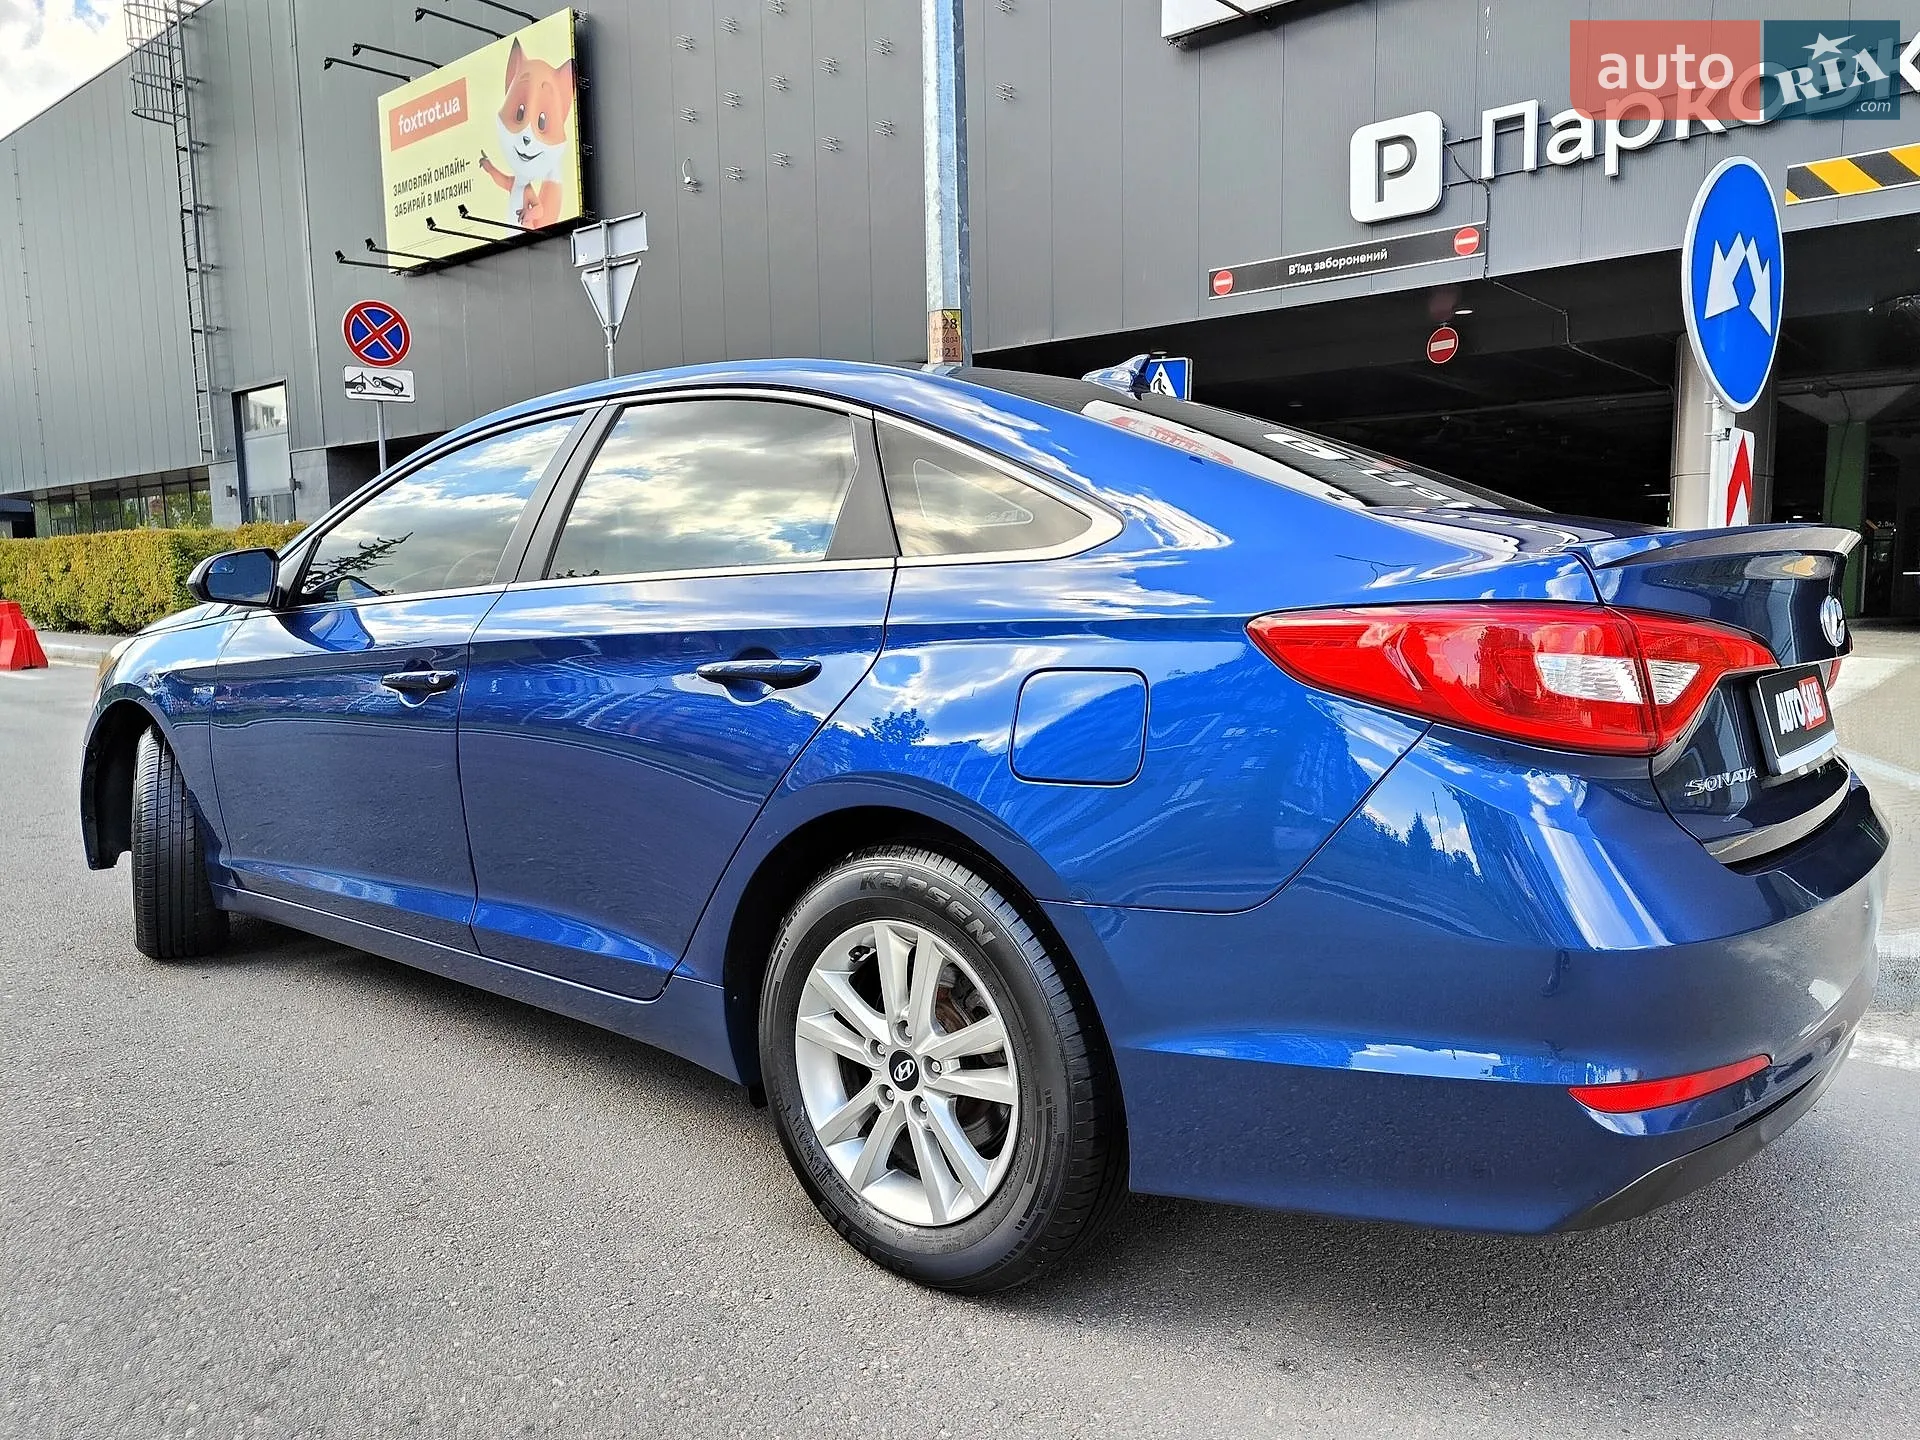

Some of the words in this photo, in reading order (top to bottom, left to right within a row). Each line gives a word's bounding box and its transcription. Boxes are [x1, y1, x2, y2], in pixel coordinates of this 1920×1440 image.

[398, 96, 461, 136] foxtrot.ua
[393, 167, 433, 197] ЗАМОВЛЯЙ
[394, 192, 427, 218] ЗАБИРАЙ
[428, 193, 433, 207] В
[1313, 248, 1388, 270] заборонений
[1685, 766, 1758, 797] SONATA
